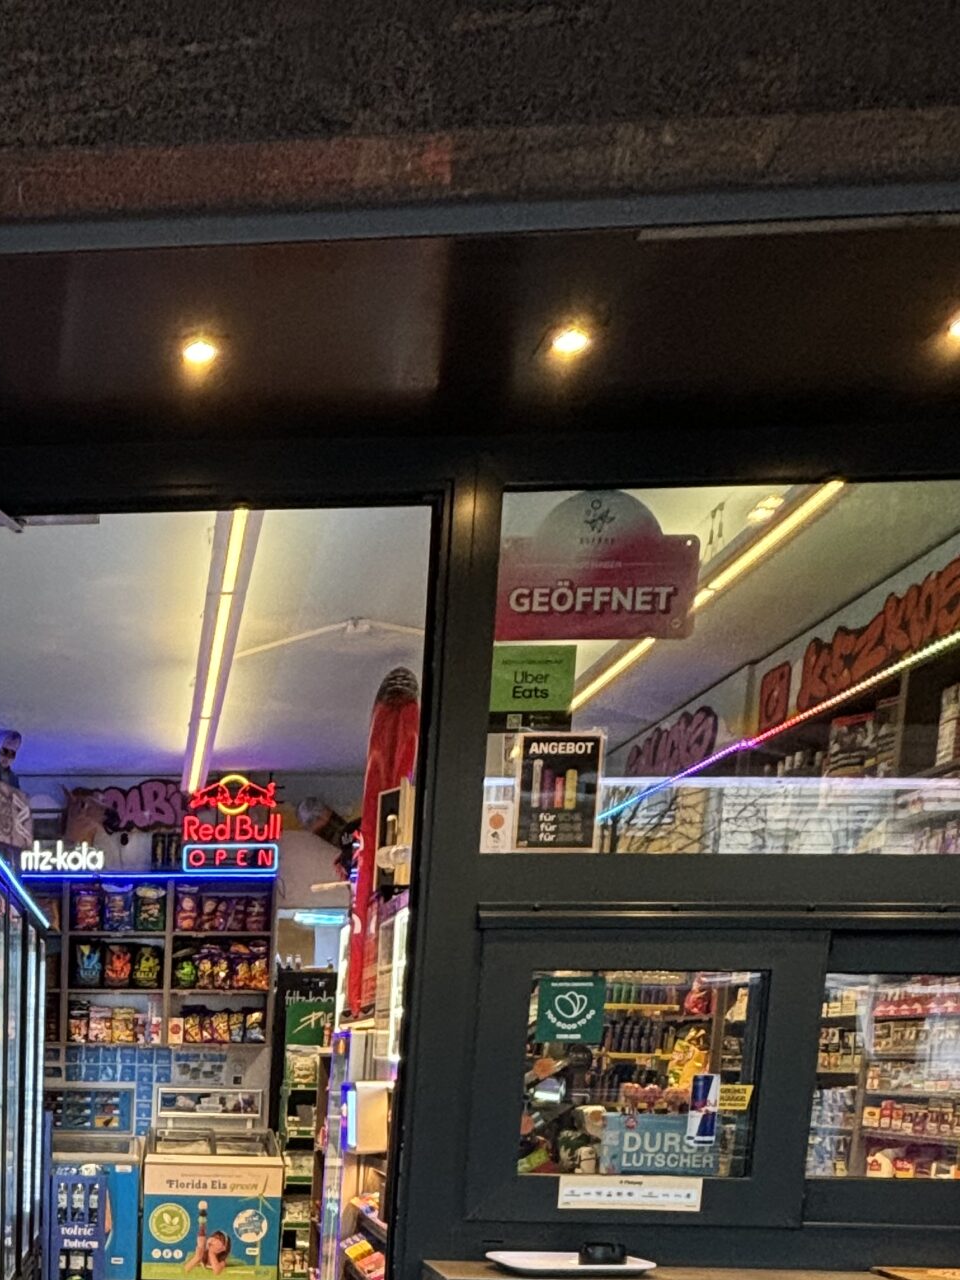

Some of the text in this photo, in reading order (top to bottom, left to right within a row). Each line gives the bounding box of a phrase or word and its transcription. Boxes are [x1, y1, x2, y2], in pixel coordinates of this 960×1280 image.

[508, 579, 676, 614] GEÖFFNET
[513, 670, 551, 685] Uber
[511, 685, 550, 700] Eats
[528, 741, 595, 755] ANGEBOT
[538, 812, 556, 822] für
[182, 813, 282, 842] Red Bull
[539, 822, 557, 832] für
[538, 832, 556, 842] für
[20, 839, 105, 872] ritz-kola
[189, 848, 274, 867] OPEN
[620, 1151, 714, 1169] LUTSCHER
[166, 1178, 208, 1191] Florida
[209, 1179, 228, 1191] Eis
